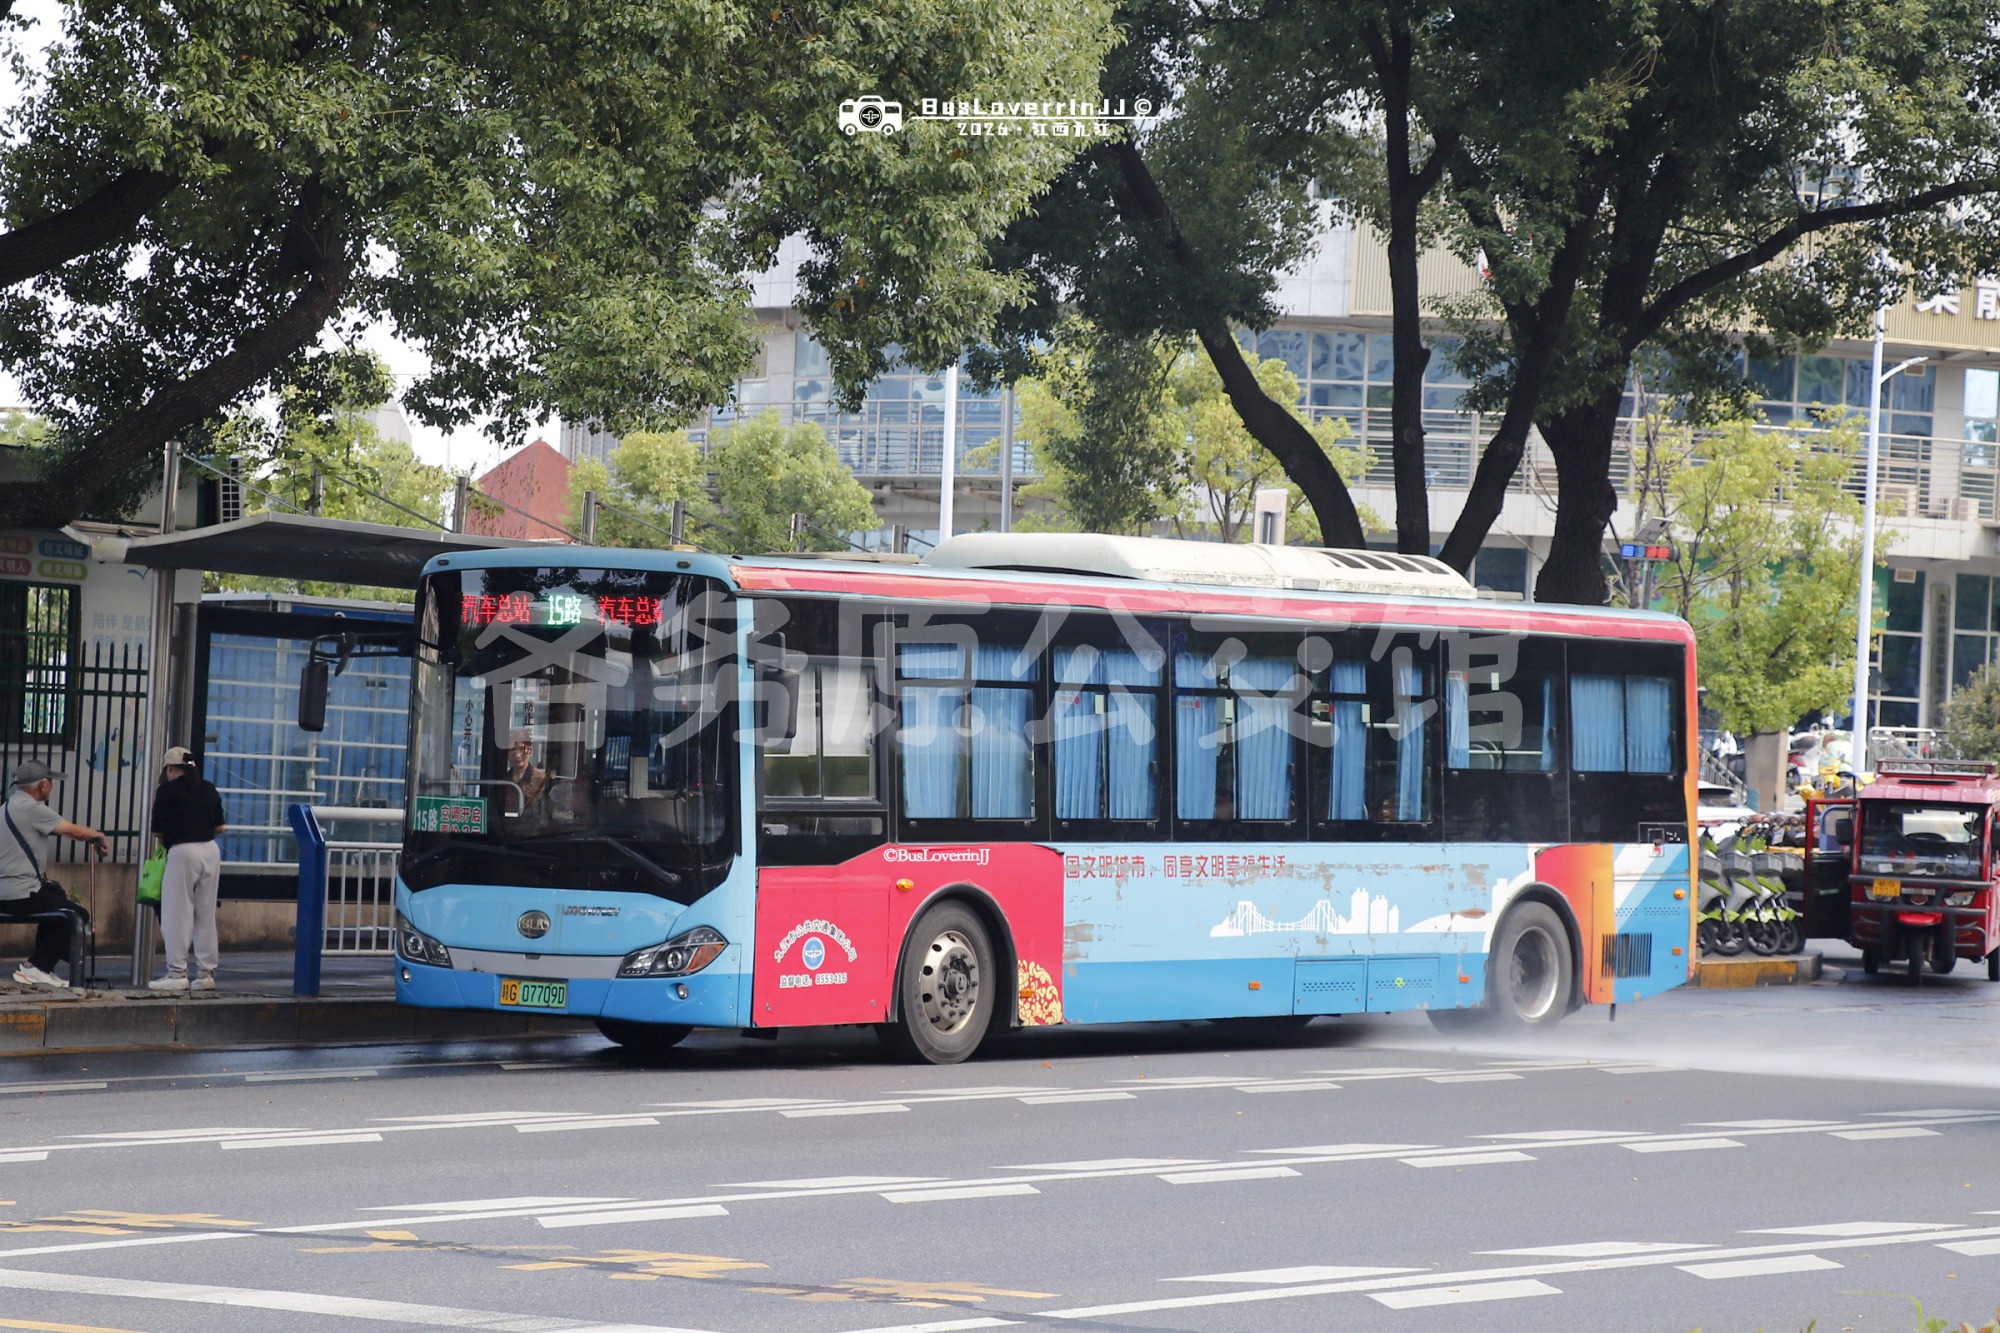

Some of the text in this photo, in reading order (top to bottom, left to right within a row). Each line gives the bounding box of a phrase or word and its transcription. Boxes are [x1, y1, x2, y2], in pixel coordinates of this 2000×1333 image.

[462, 594, 531, 623] 汽车总站
[547, 595, 582, 624] 15路
[440, 805, 482, 824] 空调开启
[815, 972, 847, 985] 8553416
[521, 984, 565, 1004] 07709D
